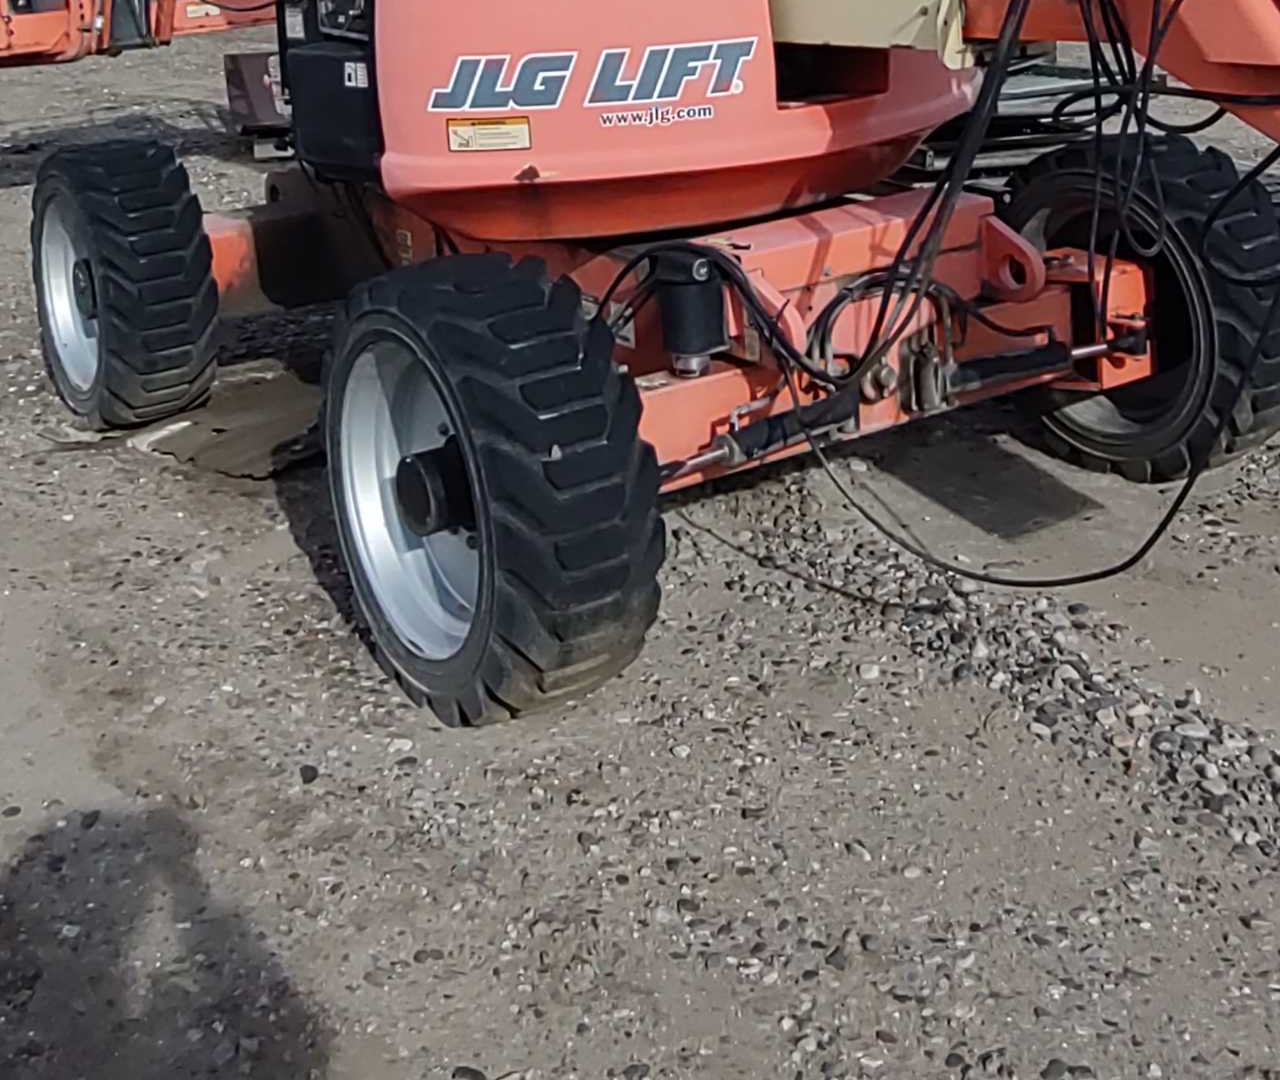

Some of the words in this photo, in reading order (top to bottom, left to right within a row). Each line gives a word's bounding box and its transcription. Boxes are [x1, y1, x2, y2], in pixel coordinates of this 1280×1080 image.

[427, 51, 578, 111] JLG
[583, 36, 759, 107] LIFT
[600, 105, 713, 126] www.jlg.com
